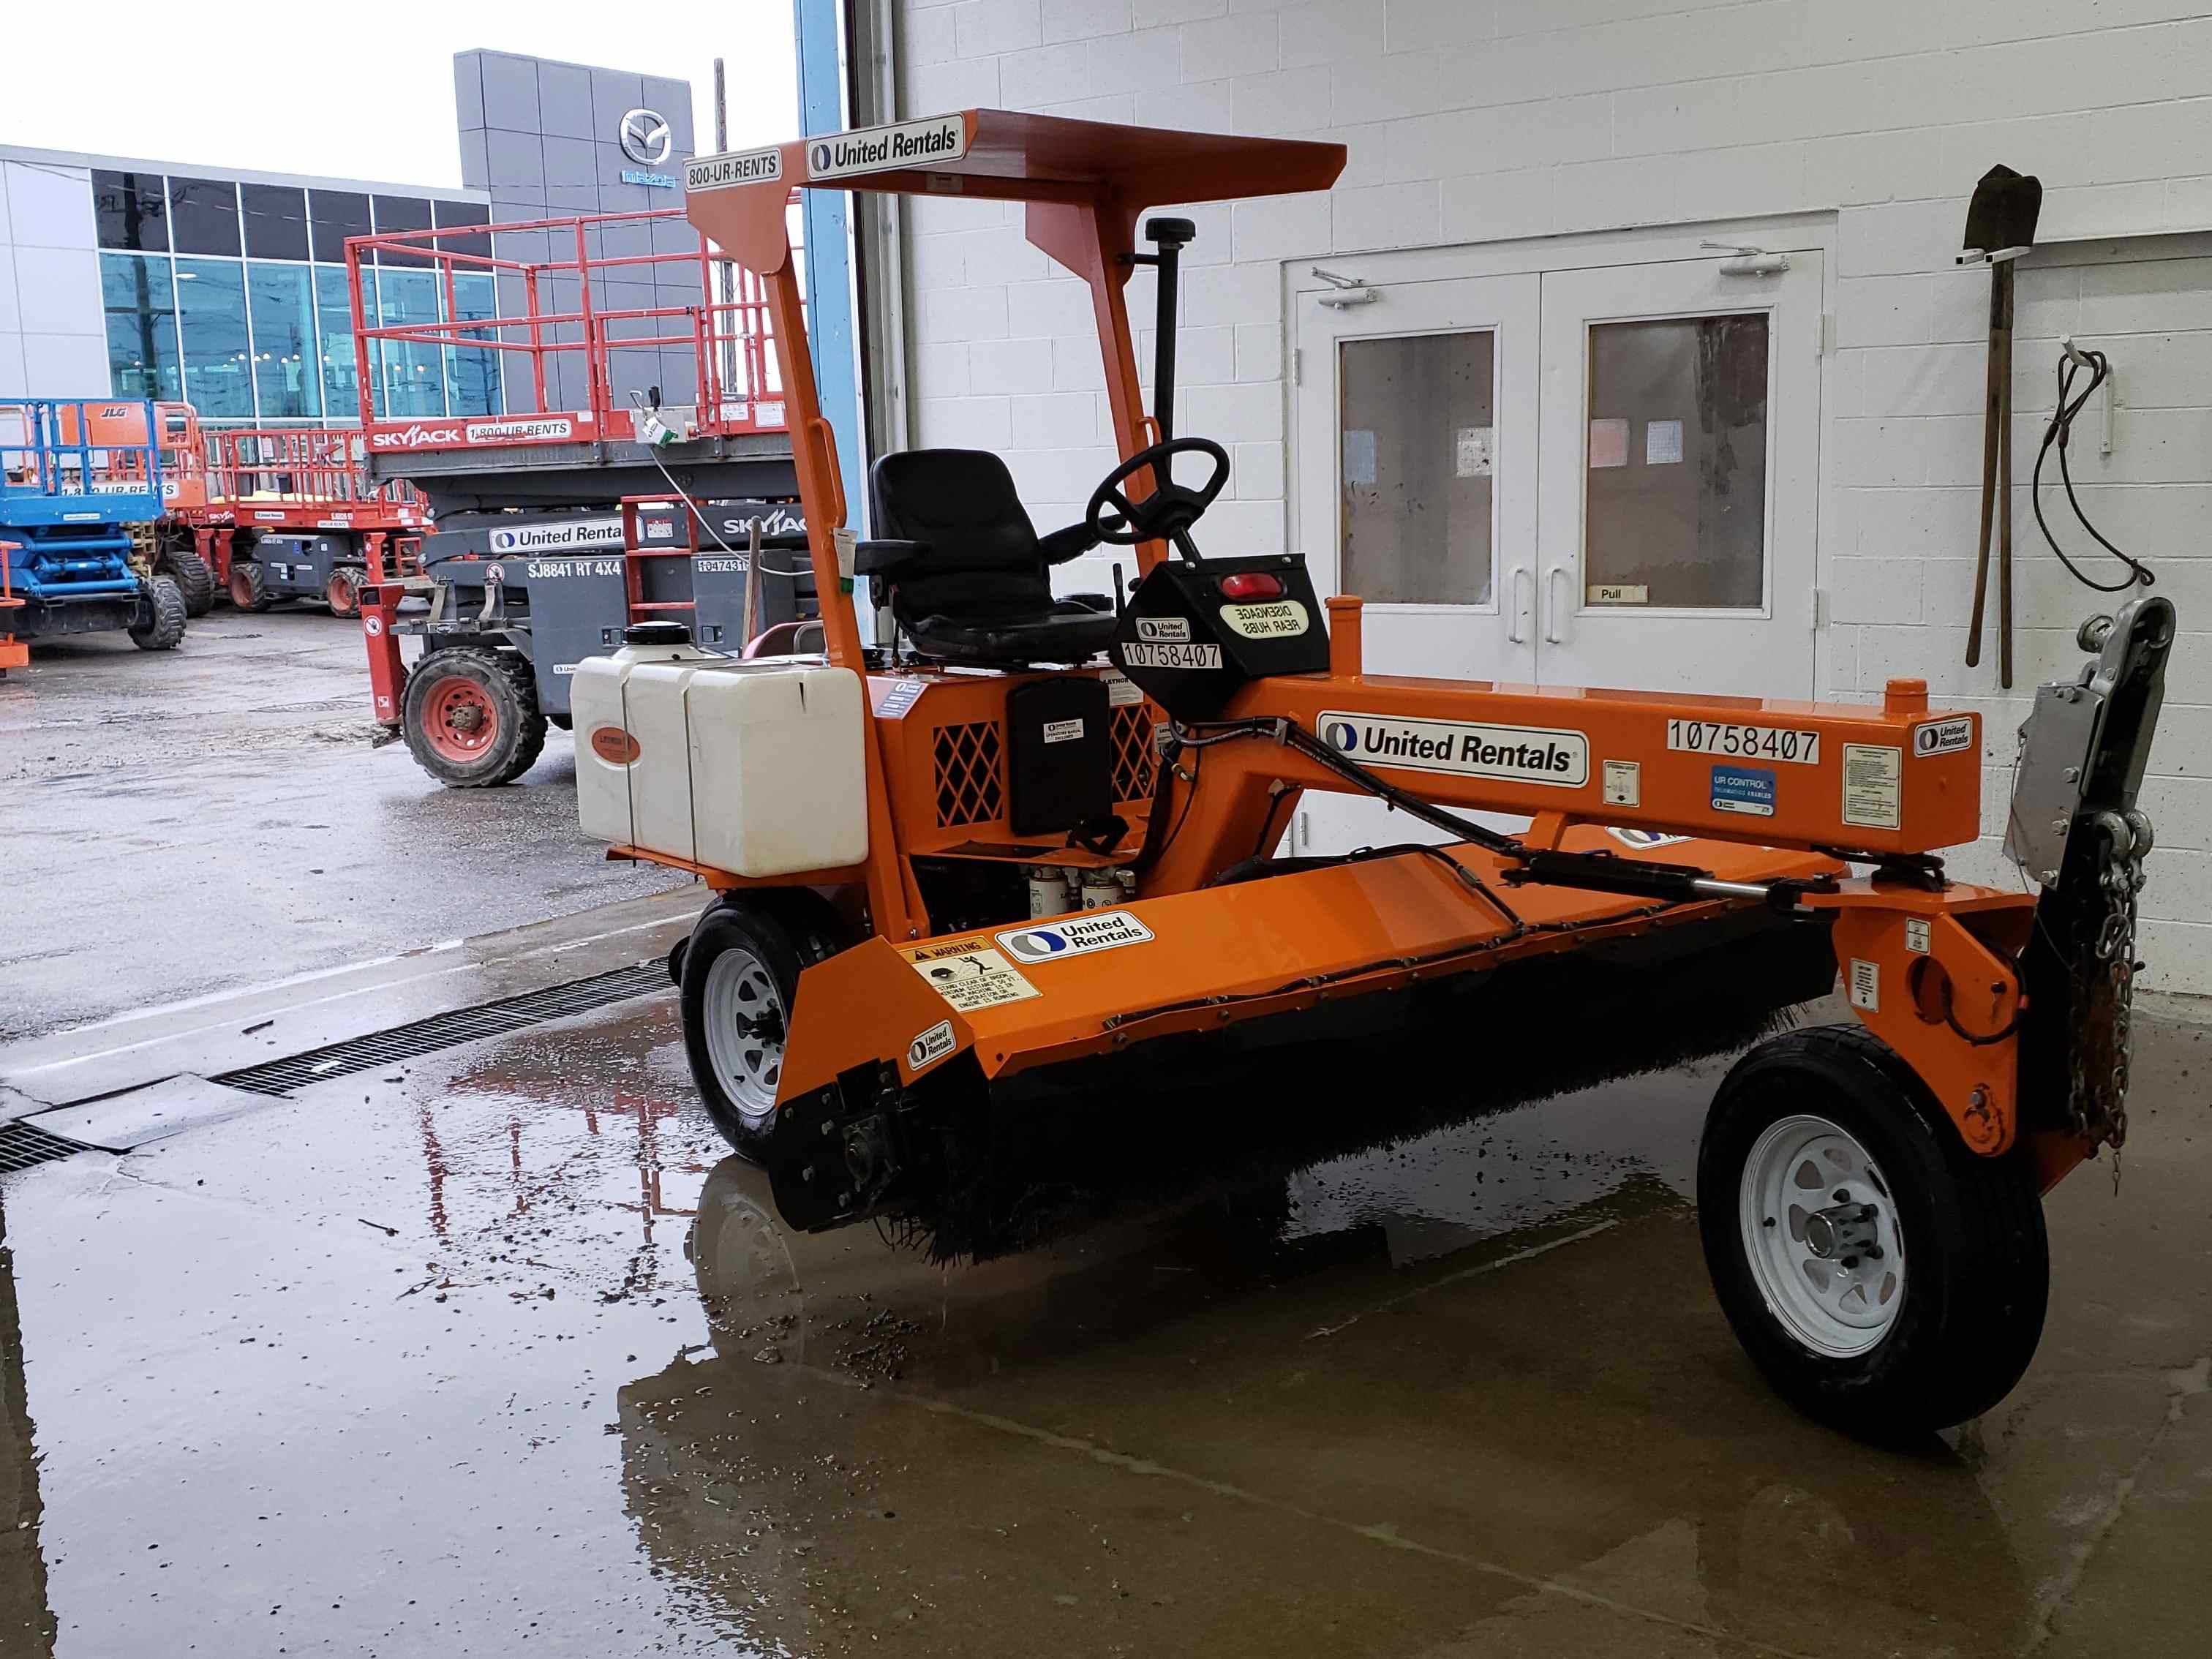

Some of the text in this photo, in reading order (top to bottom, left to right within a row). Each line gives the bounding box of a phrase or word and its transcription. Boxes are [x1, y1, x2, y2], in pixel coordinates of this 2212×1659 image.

[835, 124, 955, 167] United Rentals
[689, 155, 776, 185] 800-UR-RENTS
[101, 407, 127, 418] JLG
[373, 424, 460, 447] SKYJACK
[519, 527, 571, 546] United
[528, 562, 621, 578] SJ8841 RT 4X4
[1601, 589, 1621, 599] Pull
[1158, 622, 1183, 631] United
[1159, 630, 1186, 639] Rentals
[1125, 644, 1218, 666] 10758407
[1941, 724, 1967, 737] United
[1364, 726, 1570, 772] United Rentals
[1671, 720, 1818, 761] 10758407
[1940, 734, 1968, 748] Rentals
[1714, 775, 1767, 789] UR CONTROL
[1060, 917, 1125, 937] United
[1072, 926, 1143, 948] Rentals
[930, 942, 982, 957] WARNING
[925, 1027, 947, 1046] United
[928, 1037, 952, 1056] Rentals
